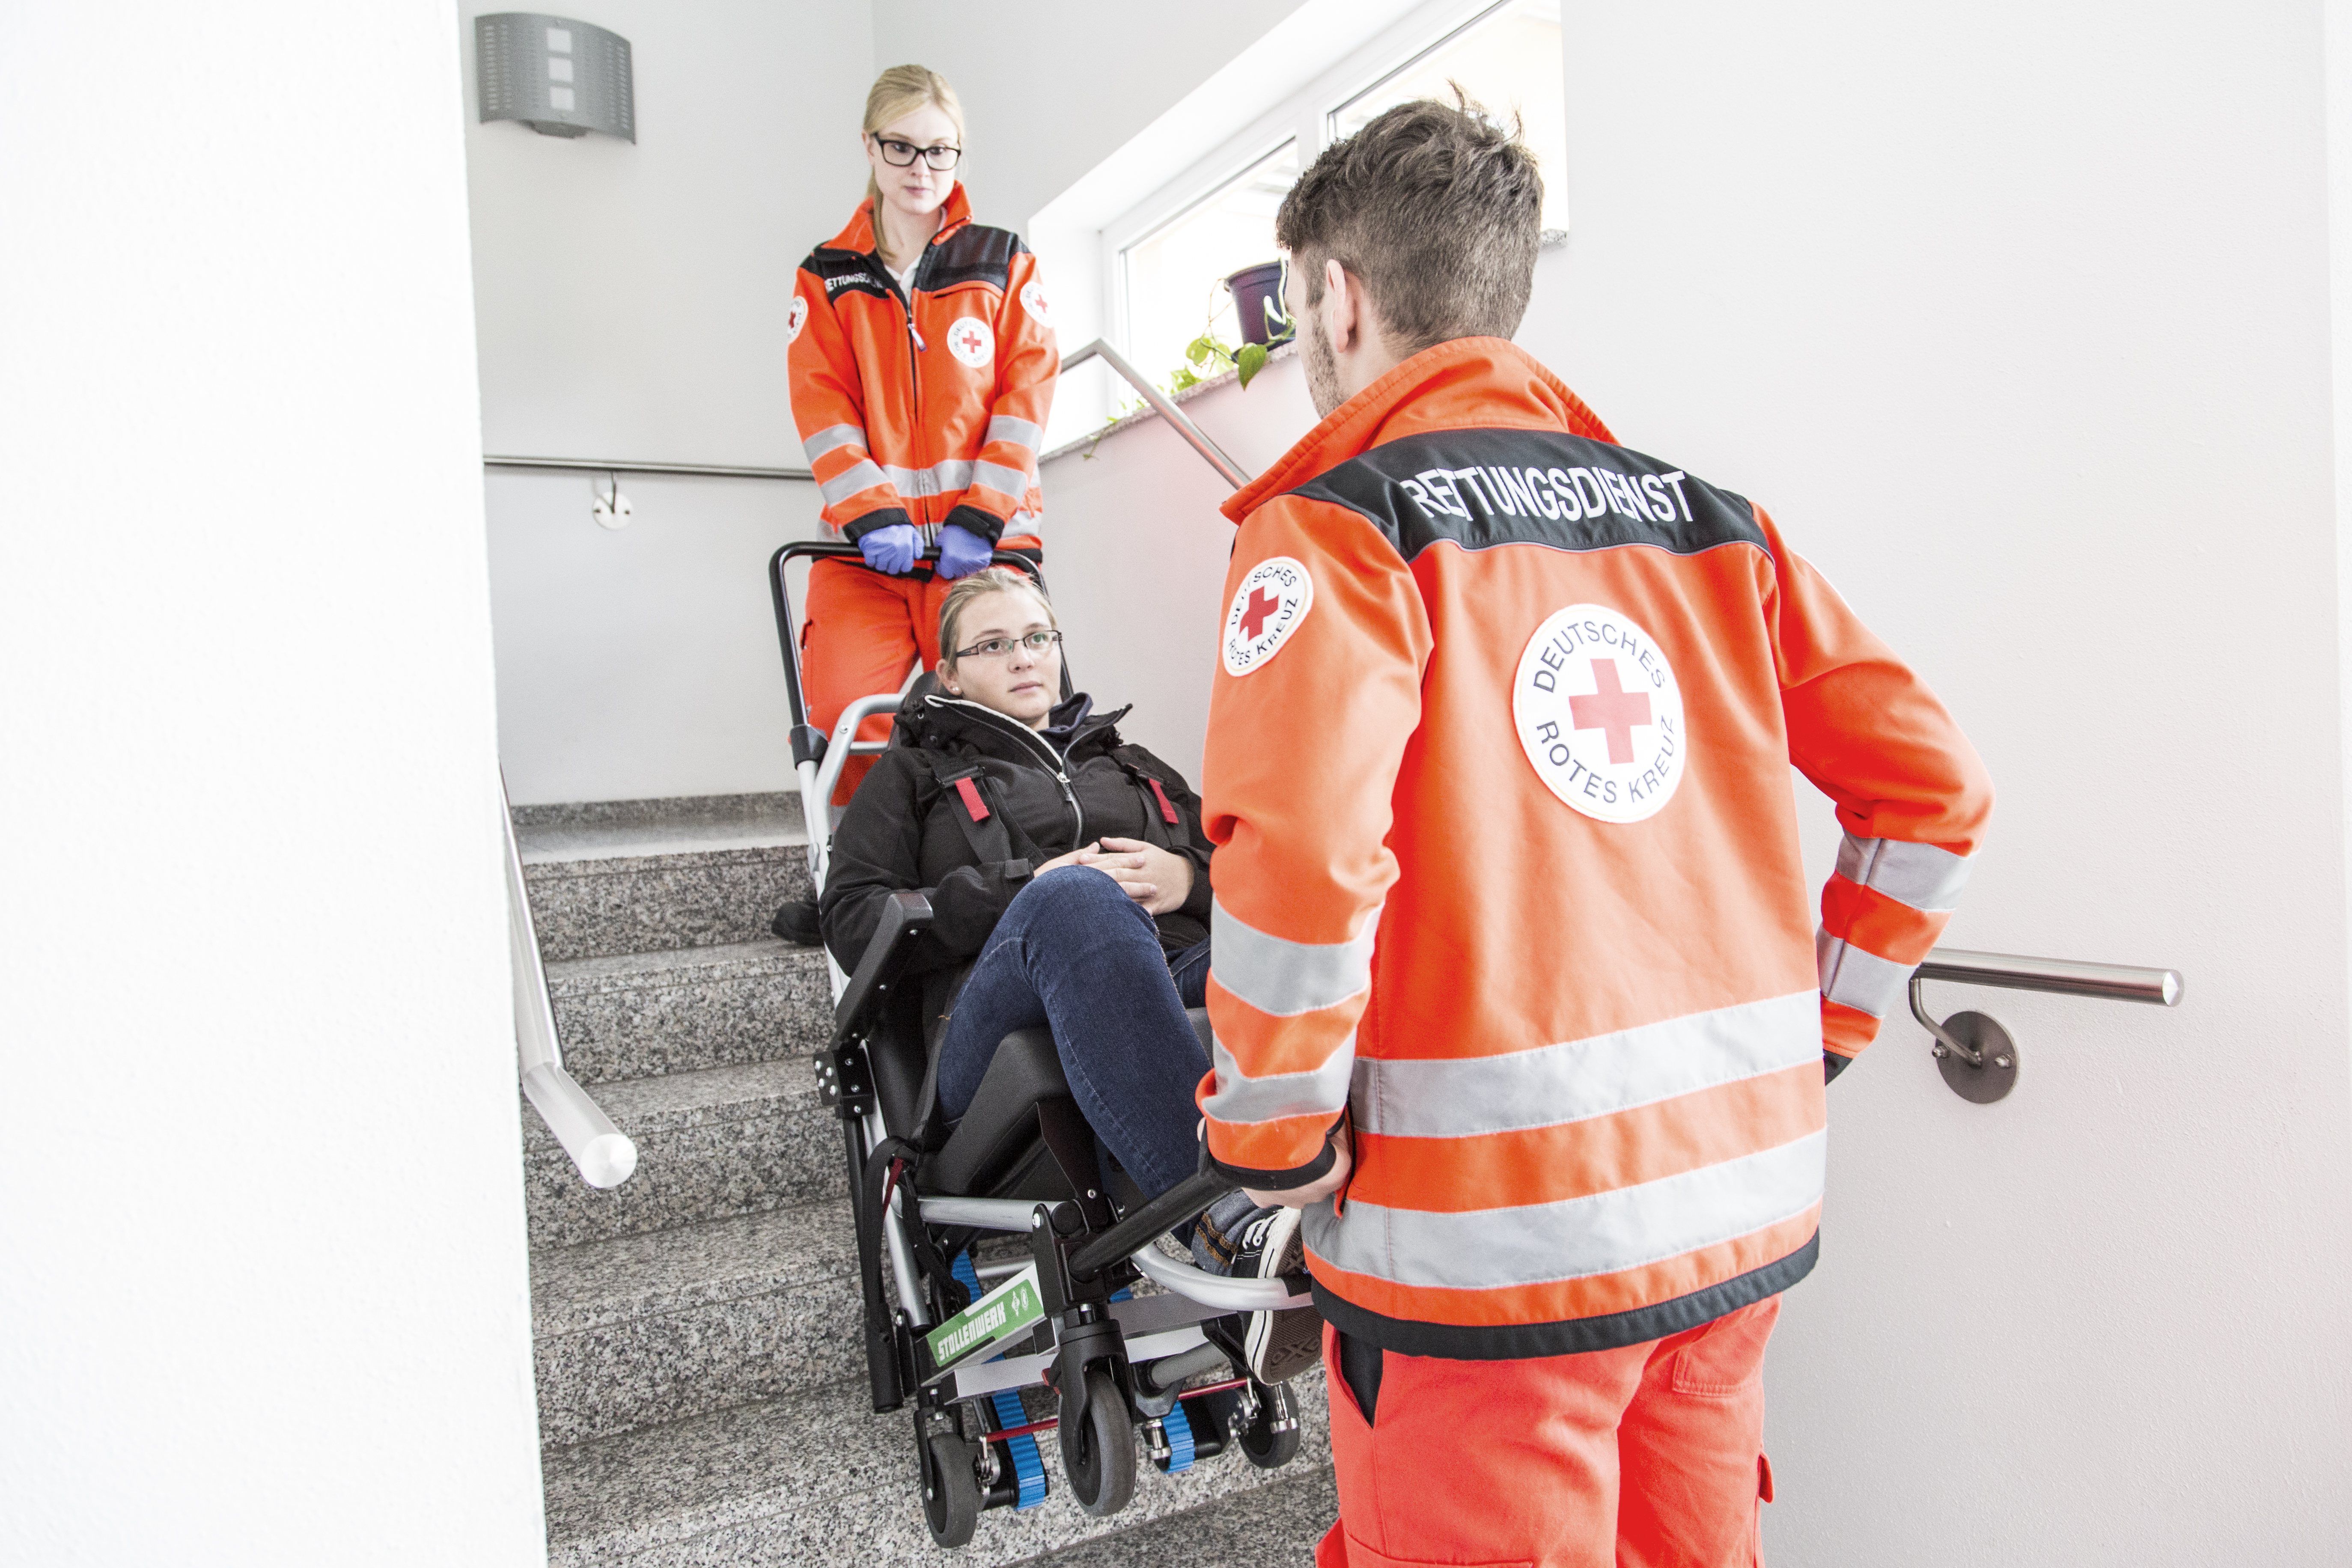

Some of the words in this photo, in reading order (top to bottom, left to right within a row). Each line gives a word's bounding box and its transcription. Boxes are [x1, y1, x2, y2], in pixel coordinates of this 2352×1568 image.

[1399, 466, 1694, 522] RETTUNGSDIENST
[1256, 598, 1298, 655] KREUZ
[1533, 620, 1665, 693] DEUTSCHES
[1536, 720, 1617, 803] ROTES
[1628, 715, 1673, 803] KREUZ
[938, 1301, 1006, 1362] STOLLENWERK
